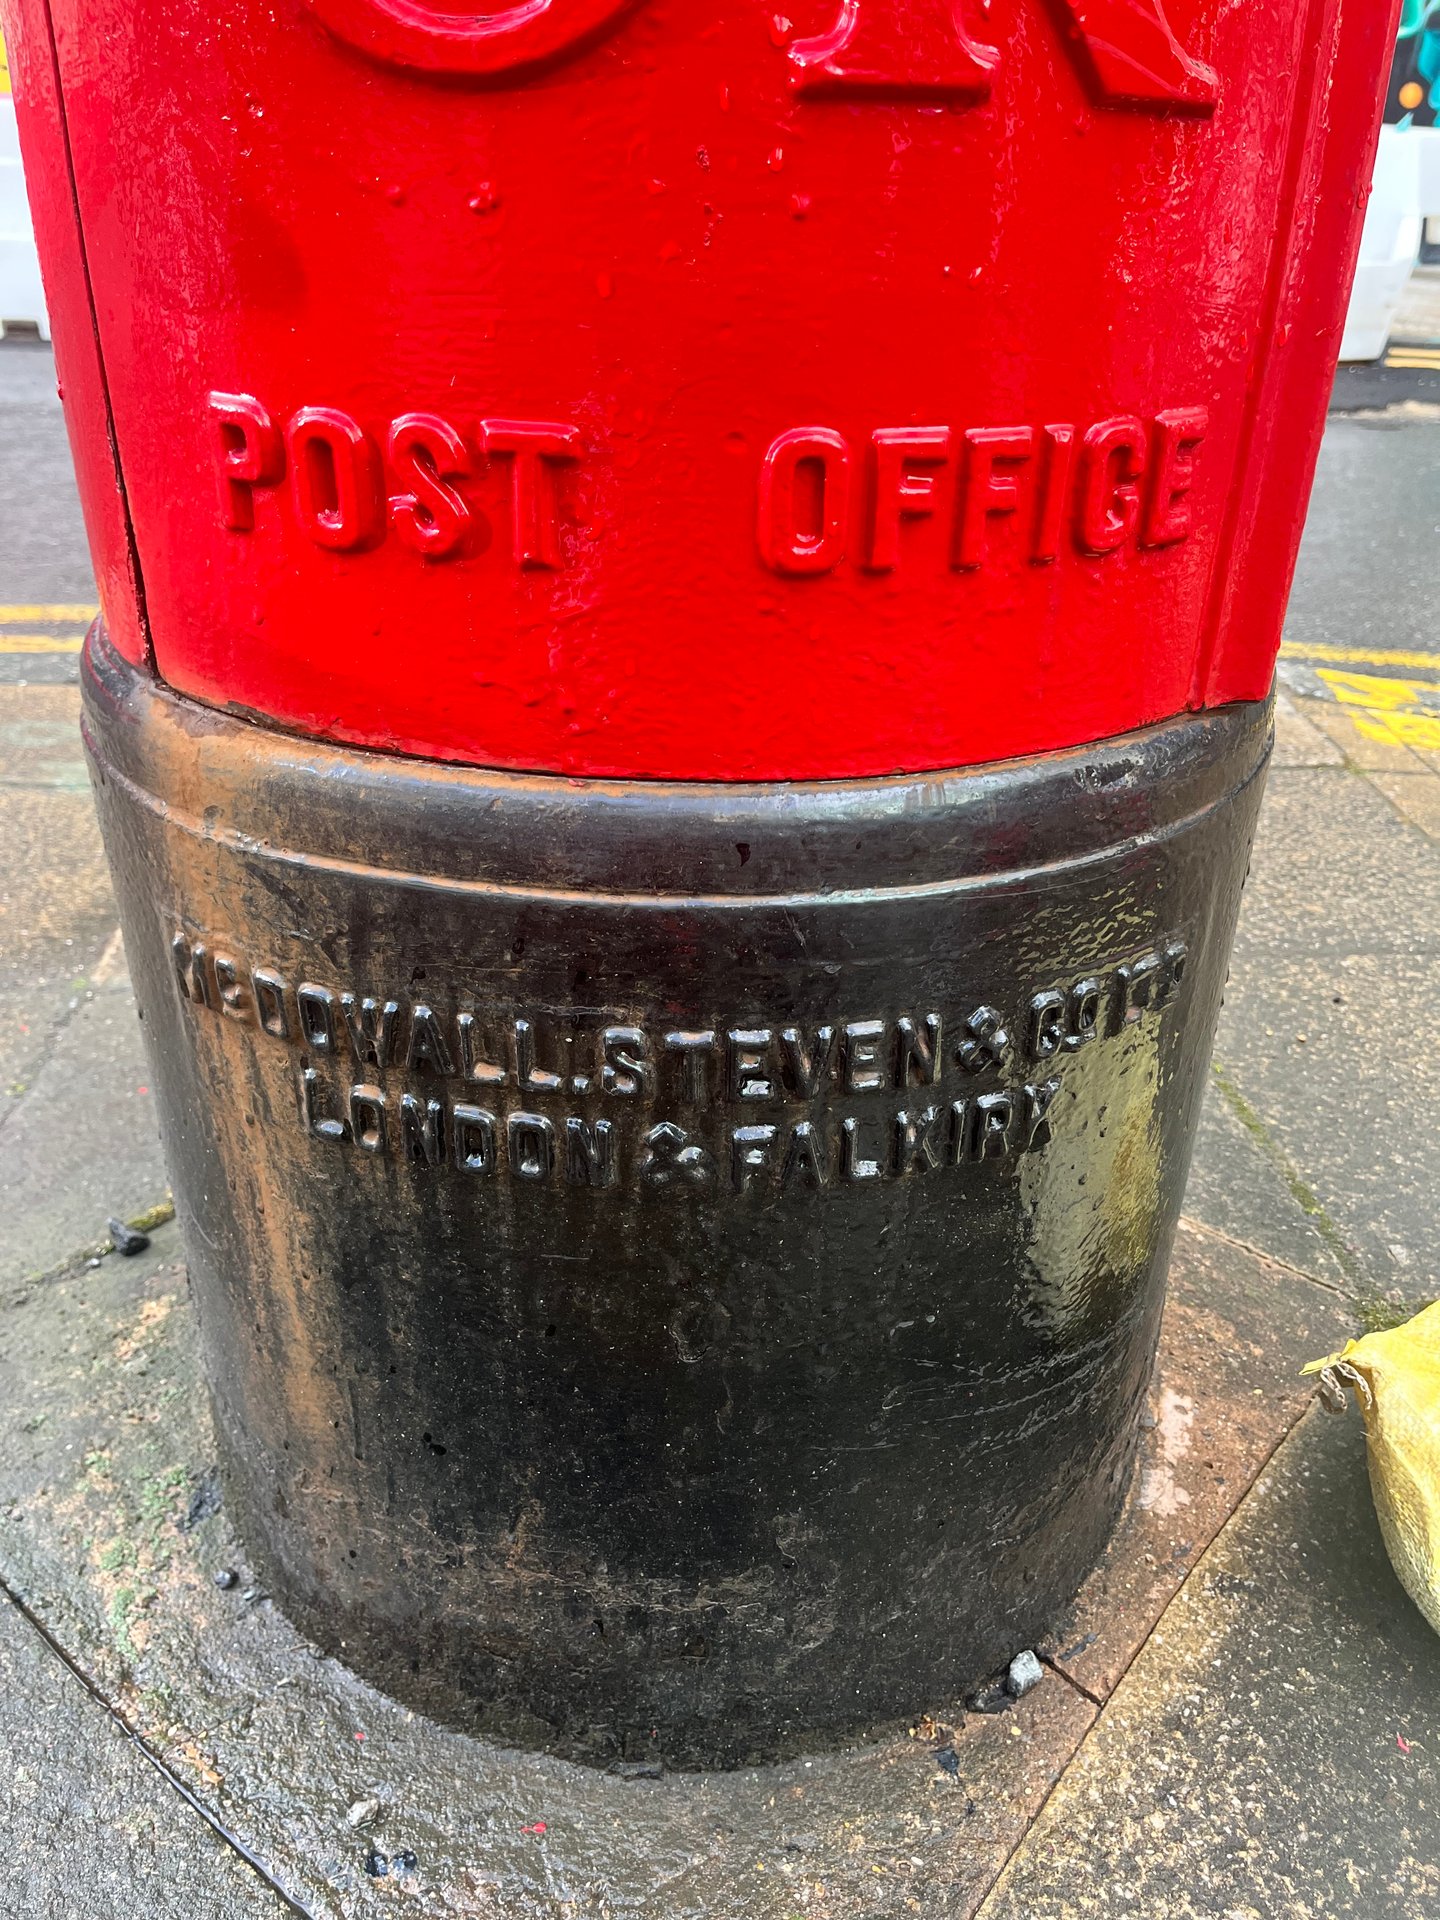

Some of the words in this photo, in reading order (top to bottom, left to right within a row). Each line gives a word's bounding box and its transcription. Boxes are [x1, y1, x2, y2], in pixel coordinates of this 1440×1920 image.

[208, 390, 580, 570] POST
[757, 406, 1209, 576] OFFICE
[955, 1004, 1011, 1075] &
[302, 1067, 618, 1189] LONDON
[640, 1120, 708, 1190] &
[730, 1074, 1063, 1195] FALKIRK
